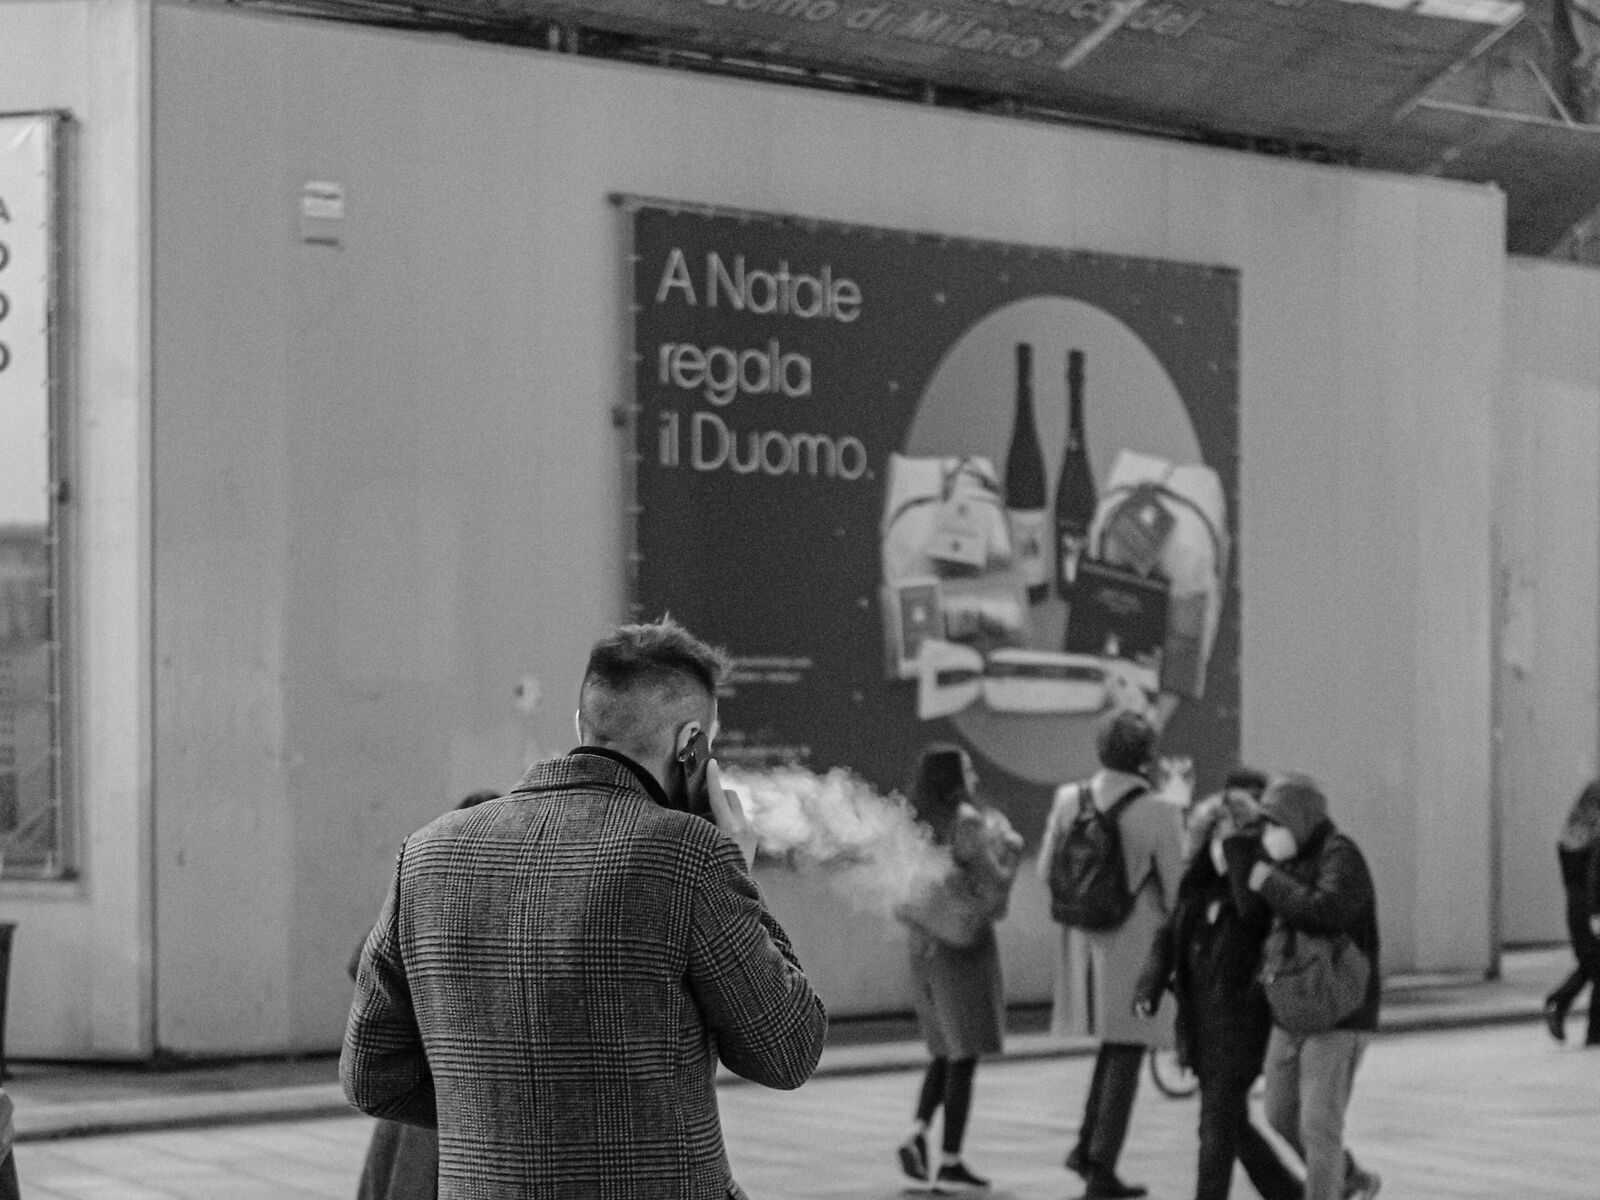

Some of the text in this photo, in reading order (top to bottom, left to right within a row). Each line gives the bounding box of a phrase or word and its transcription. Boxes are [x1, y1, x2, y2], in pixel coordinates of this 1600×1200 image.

[892, 8, 1042, 58] Milano
[655, 246, 863, 323] A Natale
[658, 336, 812, 406] regala
[658, 410, 875, 480] il Duomo.
